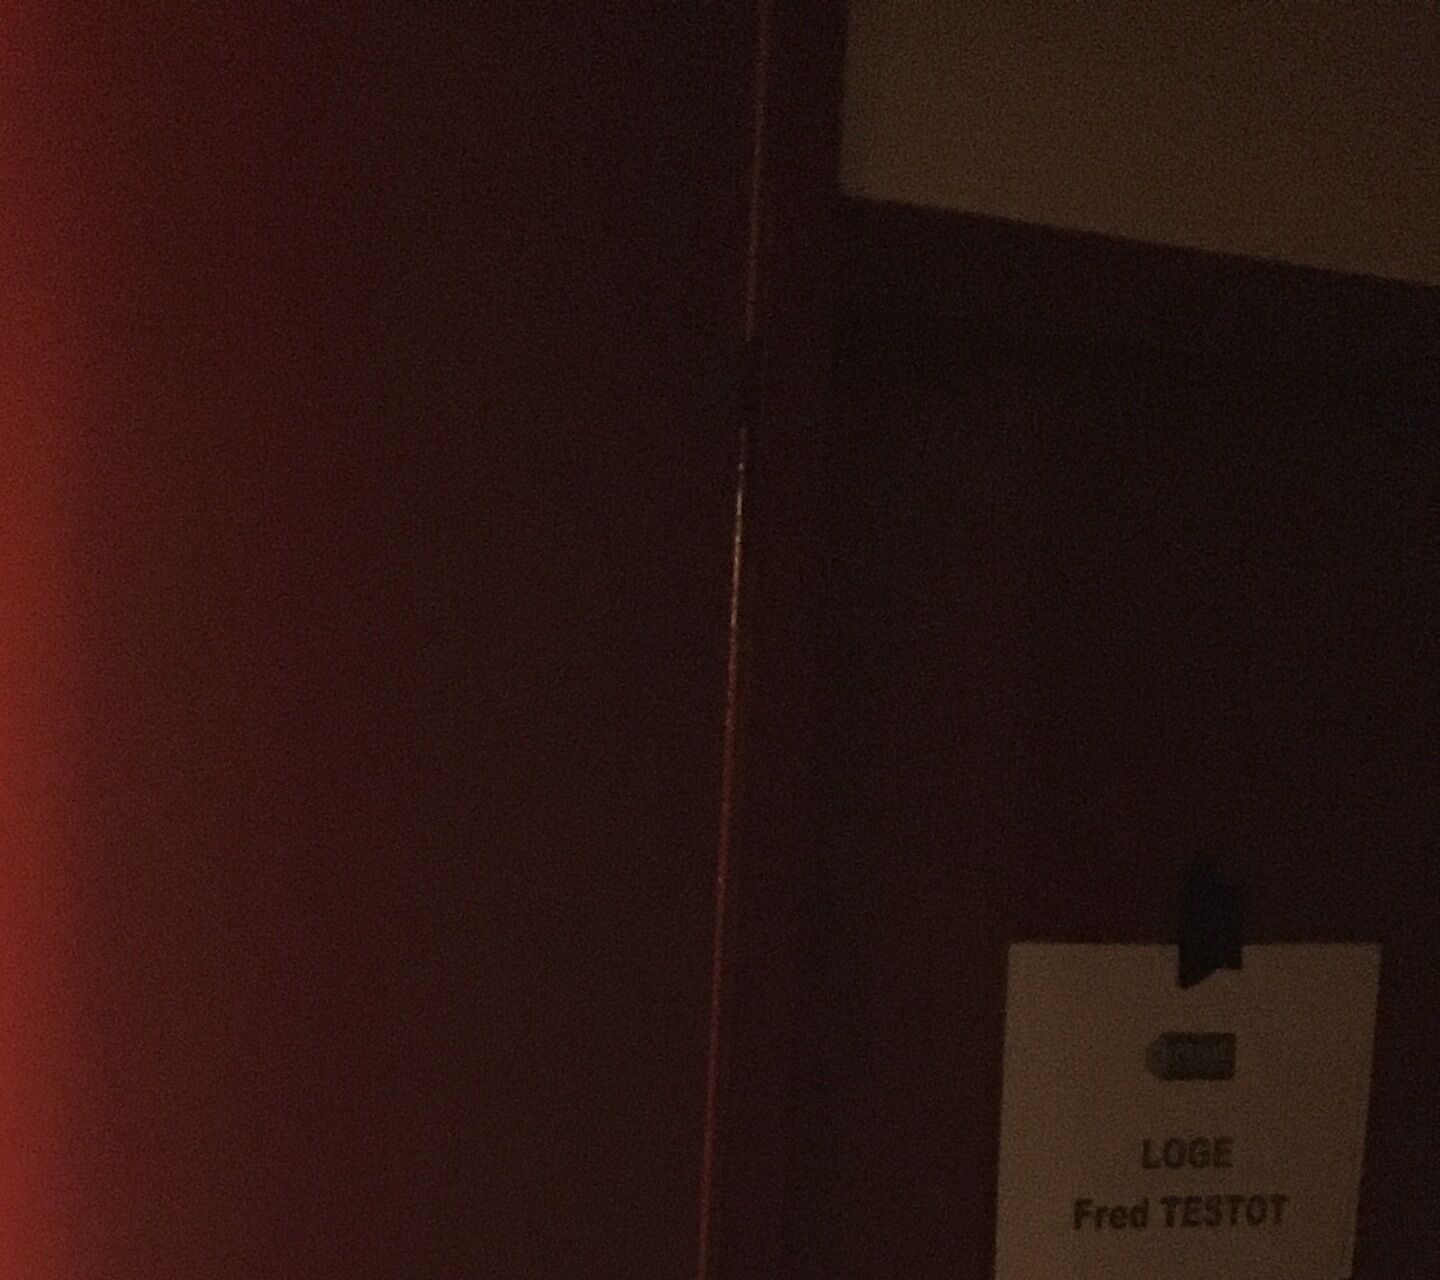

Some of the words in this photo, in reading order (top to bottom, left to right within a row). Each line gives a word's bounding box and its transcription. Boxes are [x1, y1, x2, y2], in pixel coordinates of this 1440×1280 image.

[1142, 1136, 1233, 1168] LOGE
[1073, 1198, 1149, 1230] Fred
[1160, 1194, 1288, 1227] TESTOT
